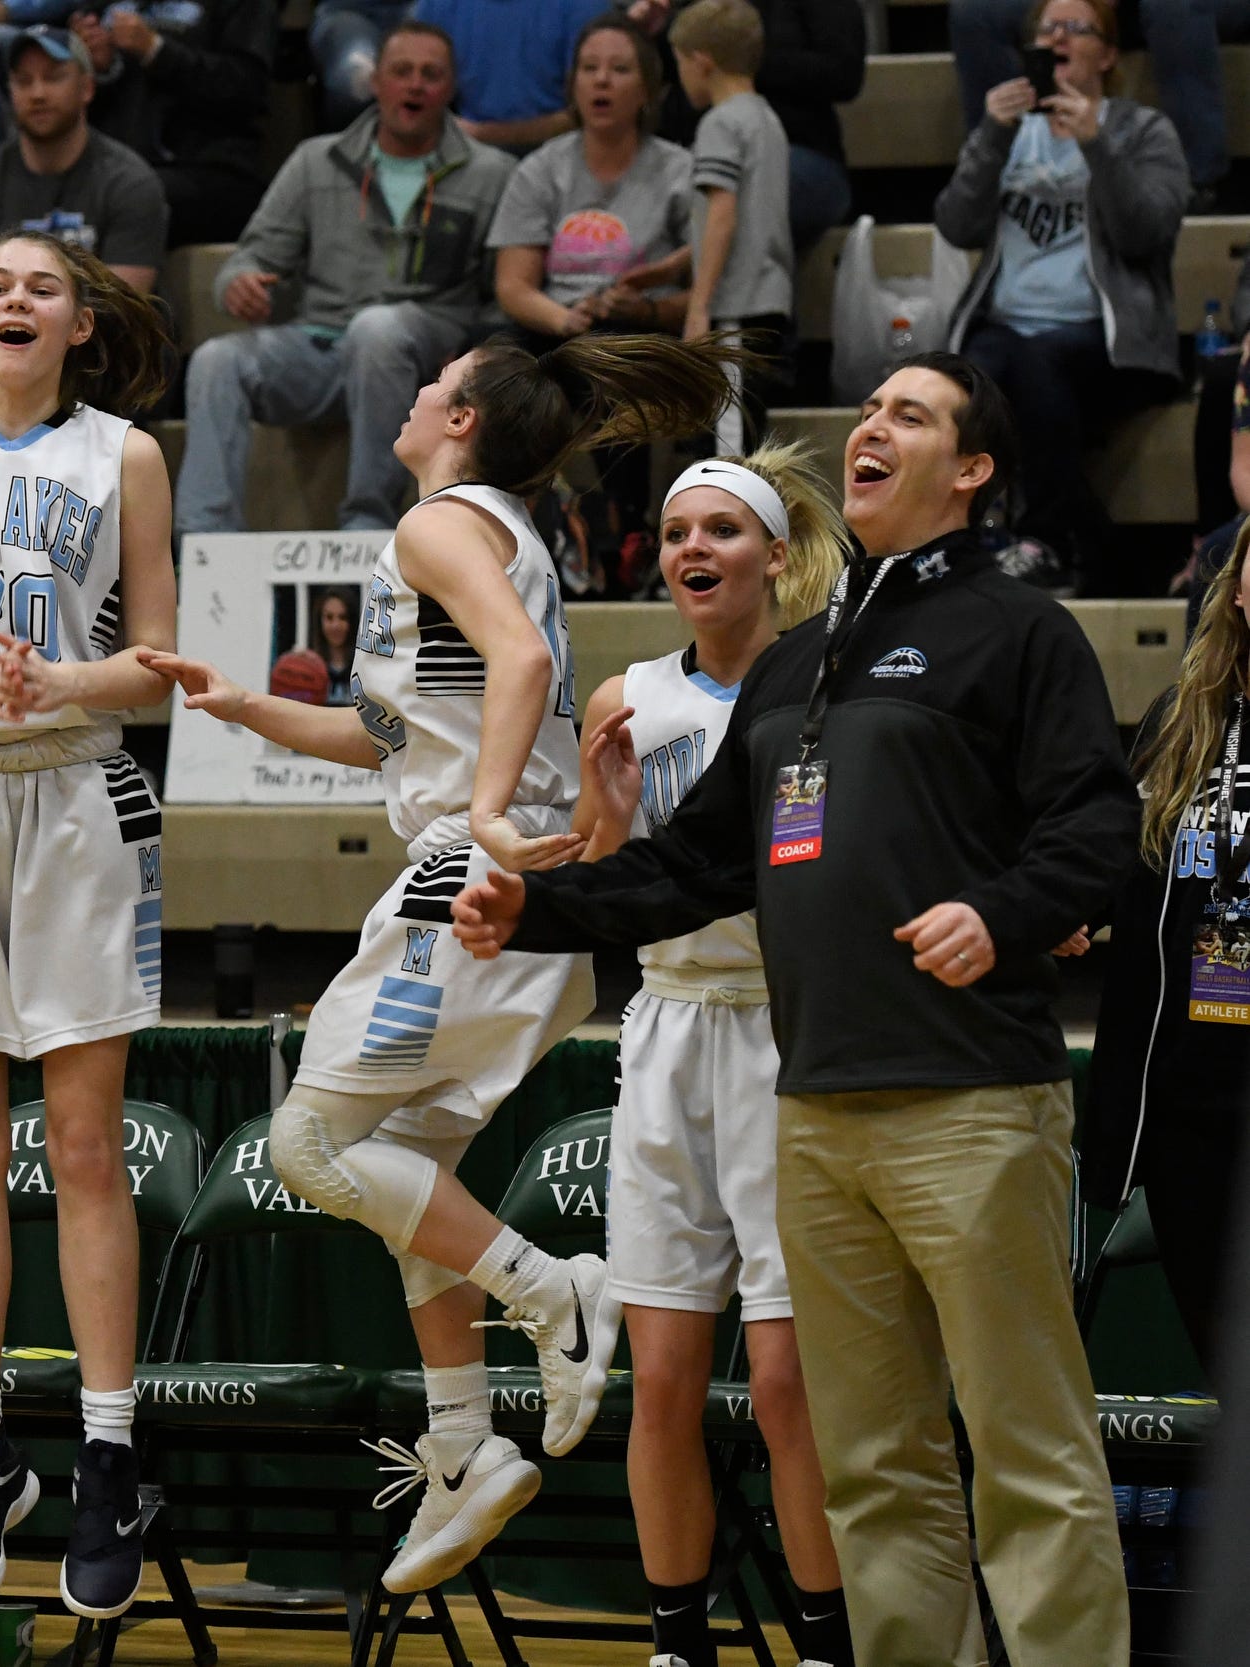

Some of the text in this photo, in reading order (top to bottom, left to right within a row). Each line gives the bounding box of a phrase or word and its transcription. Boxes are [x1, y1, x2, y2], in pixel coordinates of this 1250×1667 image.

[869, 664, 926, 676] MIDLAKES
[1221, 768, 1232, 801] REFUEL
[778, 842, 814, 858] COACH
[138, 844, 162, 894] M
[401, 926, 438, 976] M
[1195, 1004, 1248, 1019] ATHLETE
[536, 1135, 611, 1180] HU
[243, 1178, 330, 1214] VAL
[549, 1183, 607, 1217] VA
[133, 1379, 257, 1406] VIKINGS
[488, 1388, 547, 1412] ING
